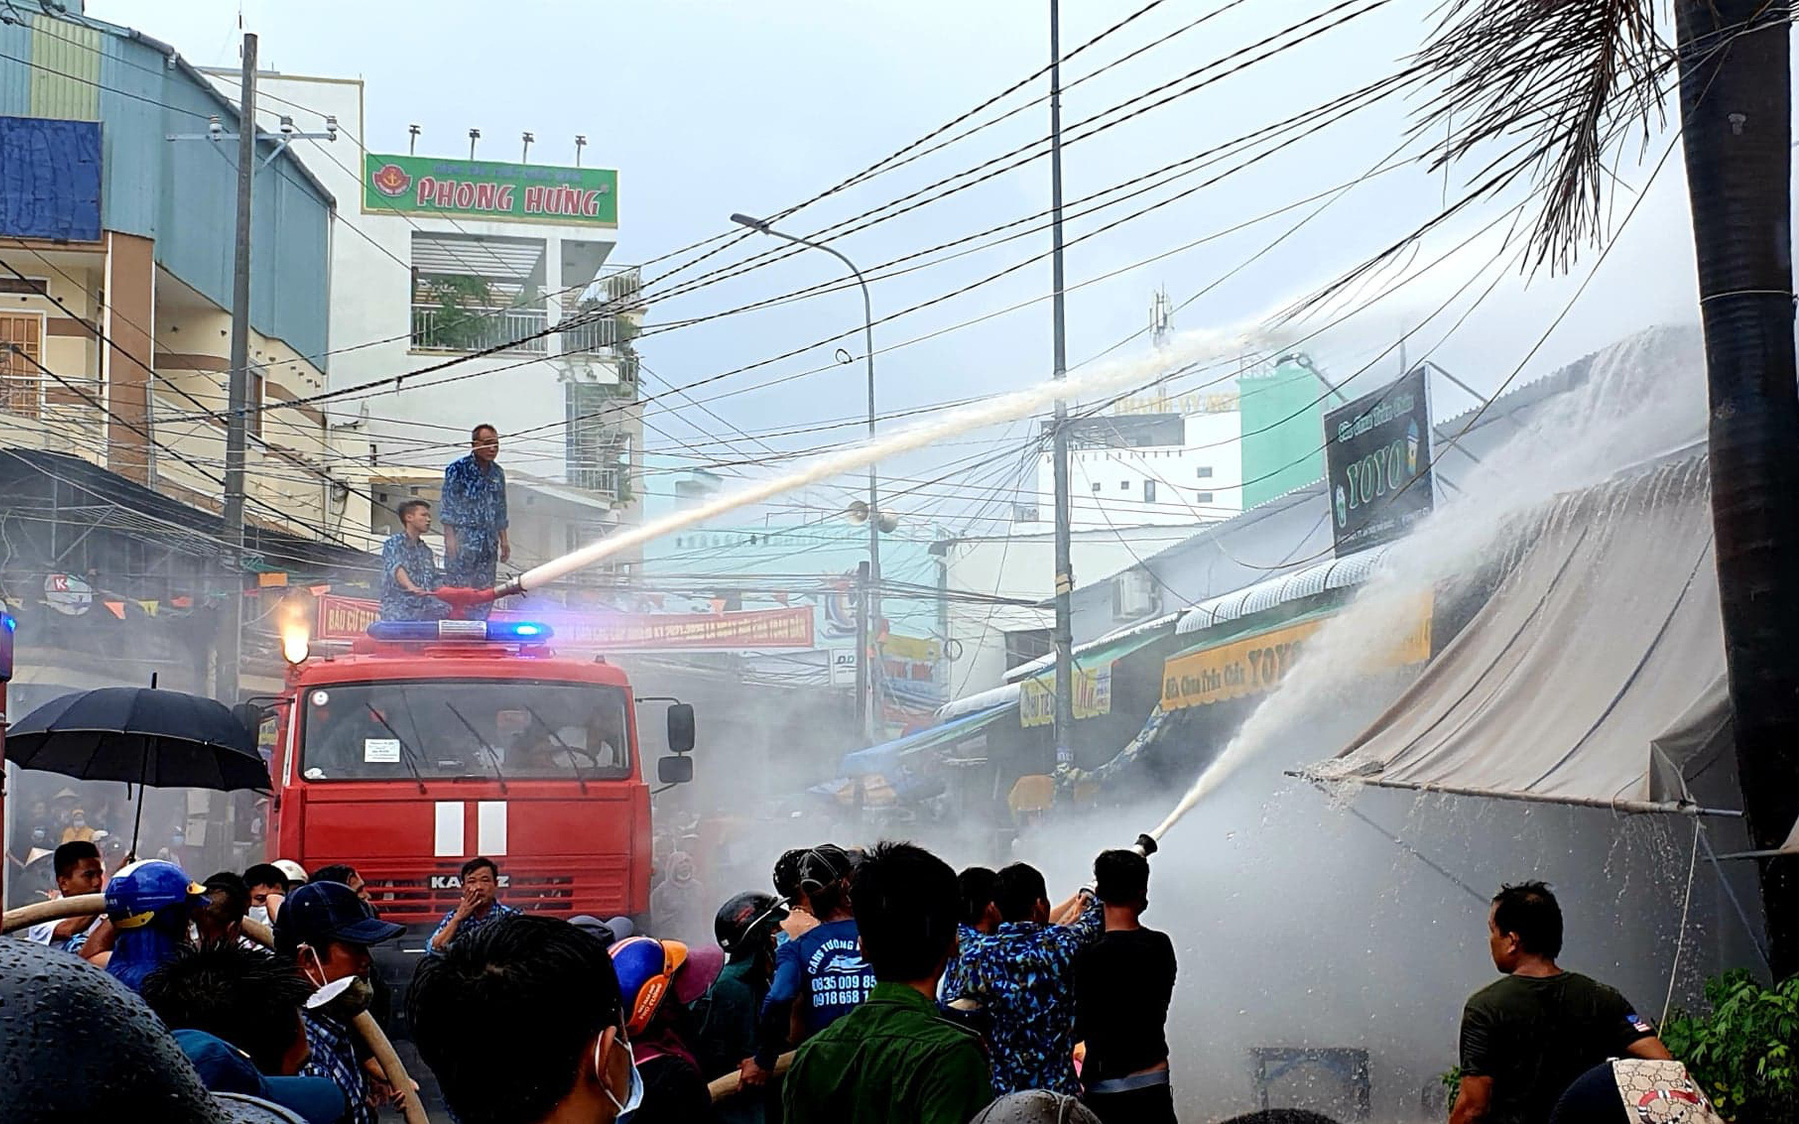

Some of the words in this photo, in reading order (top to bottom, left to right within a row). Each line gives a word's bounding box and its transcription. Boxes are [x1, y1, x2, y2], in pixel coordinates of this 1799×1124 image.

[417, 176, 516, 211] PHONG
[524, 183, 600, 217] HƯNG
[1346, 440, 1405, 509] YOYO
[432, 876, 509, 889] KAZ
[812, 976, 837, 992] 0835
[838, 975, 860, 989] 009
[863, 975, 877, 988] 85
[813, 991, 838, 1008] 0918
[839, 990, 859, 1004] 668
